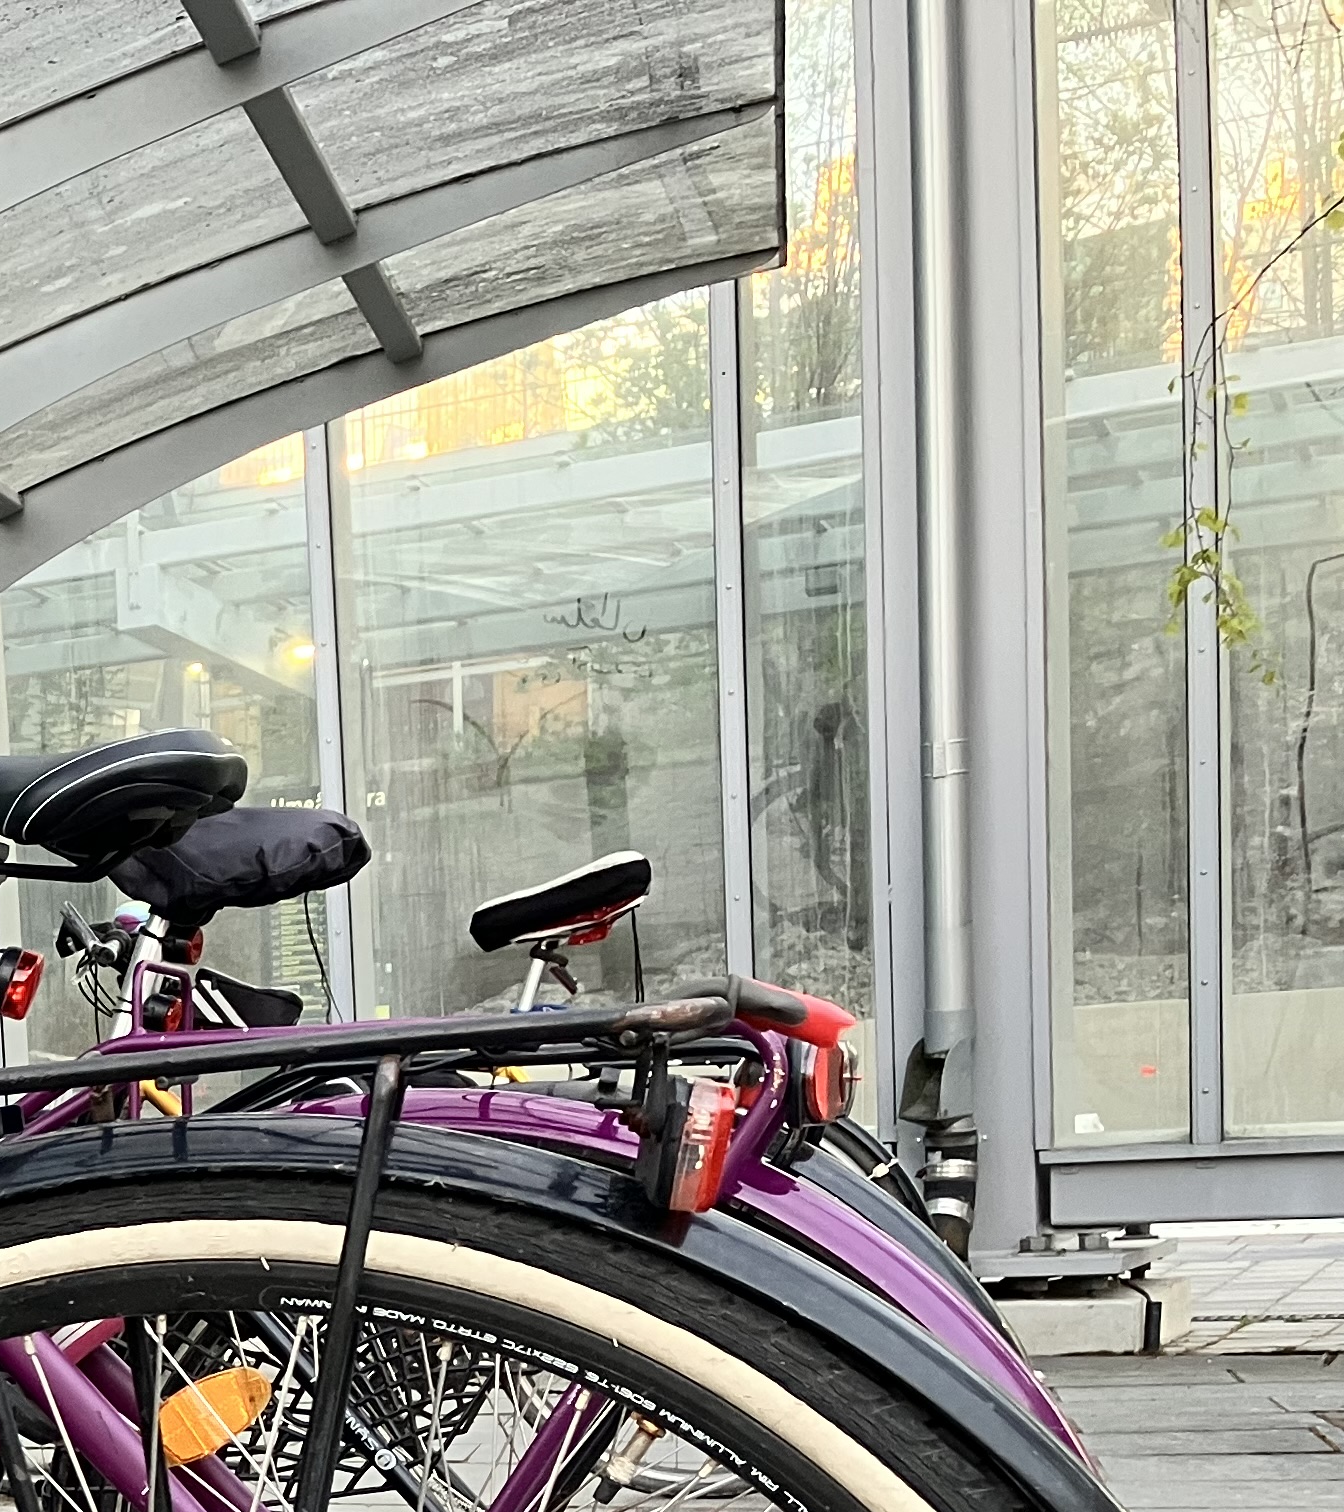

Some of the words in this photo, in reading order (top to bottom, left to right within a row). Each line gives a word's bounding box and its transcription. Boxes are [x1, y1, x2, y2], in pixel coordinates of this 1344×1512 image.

[280, 1297, 332, 1309] AIWAN
[373, 1307, 425, 1325] MADE
[659, 1409, 747, 1466] ALUMINIUM
